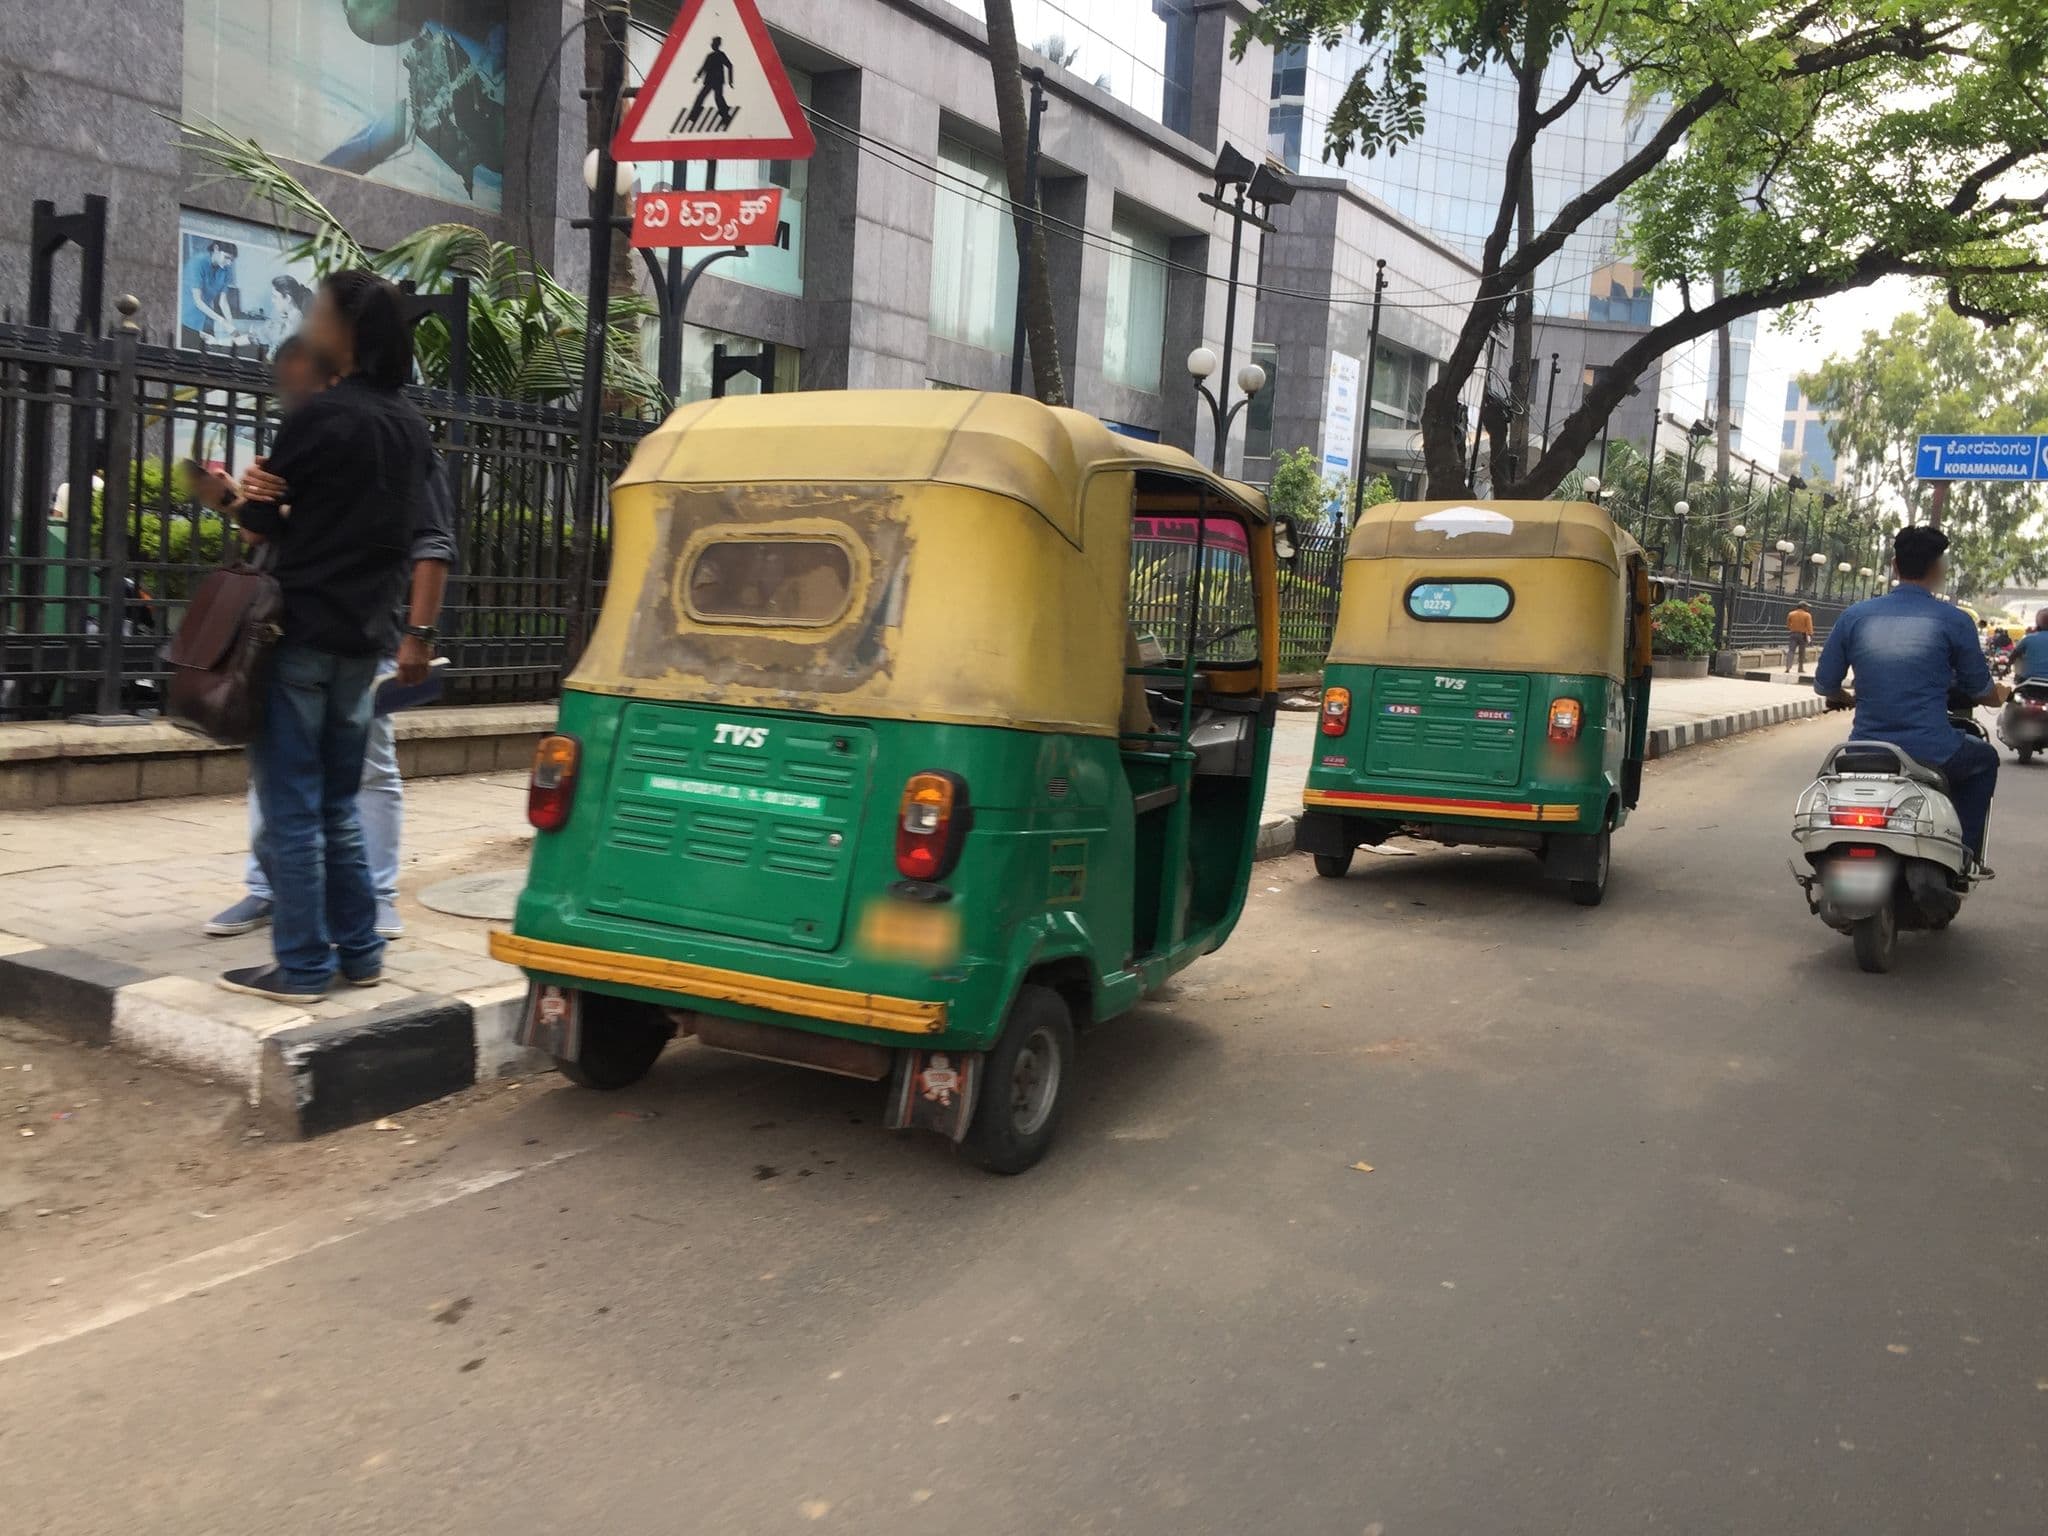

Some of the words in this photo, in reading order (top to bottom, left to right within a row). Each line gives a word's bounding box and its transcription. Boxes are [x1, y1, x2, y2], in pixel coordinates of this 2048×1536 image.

[643, 198, 670, 228] ಬಿ
[1944, 463, 2028, 475] KORAMANGALA
[1434, 676, 1466, 690] TVS
[713, 723, 770, 748] TVS
